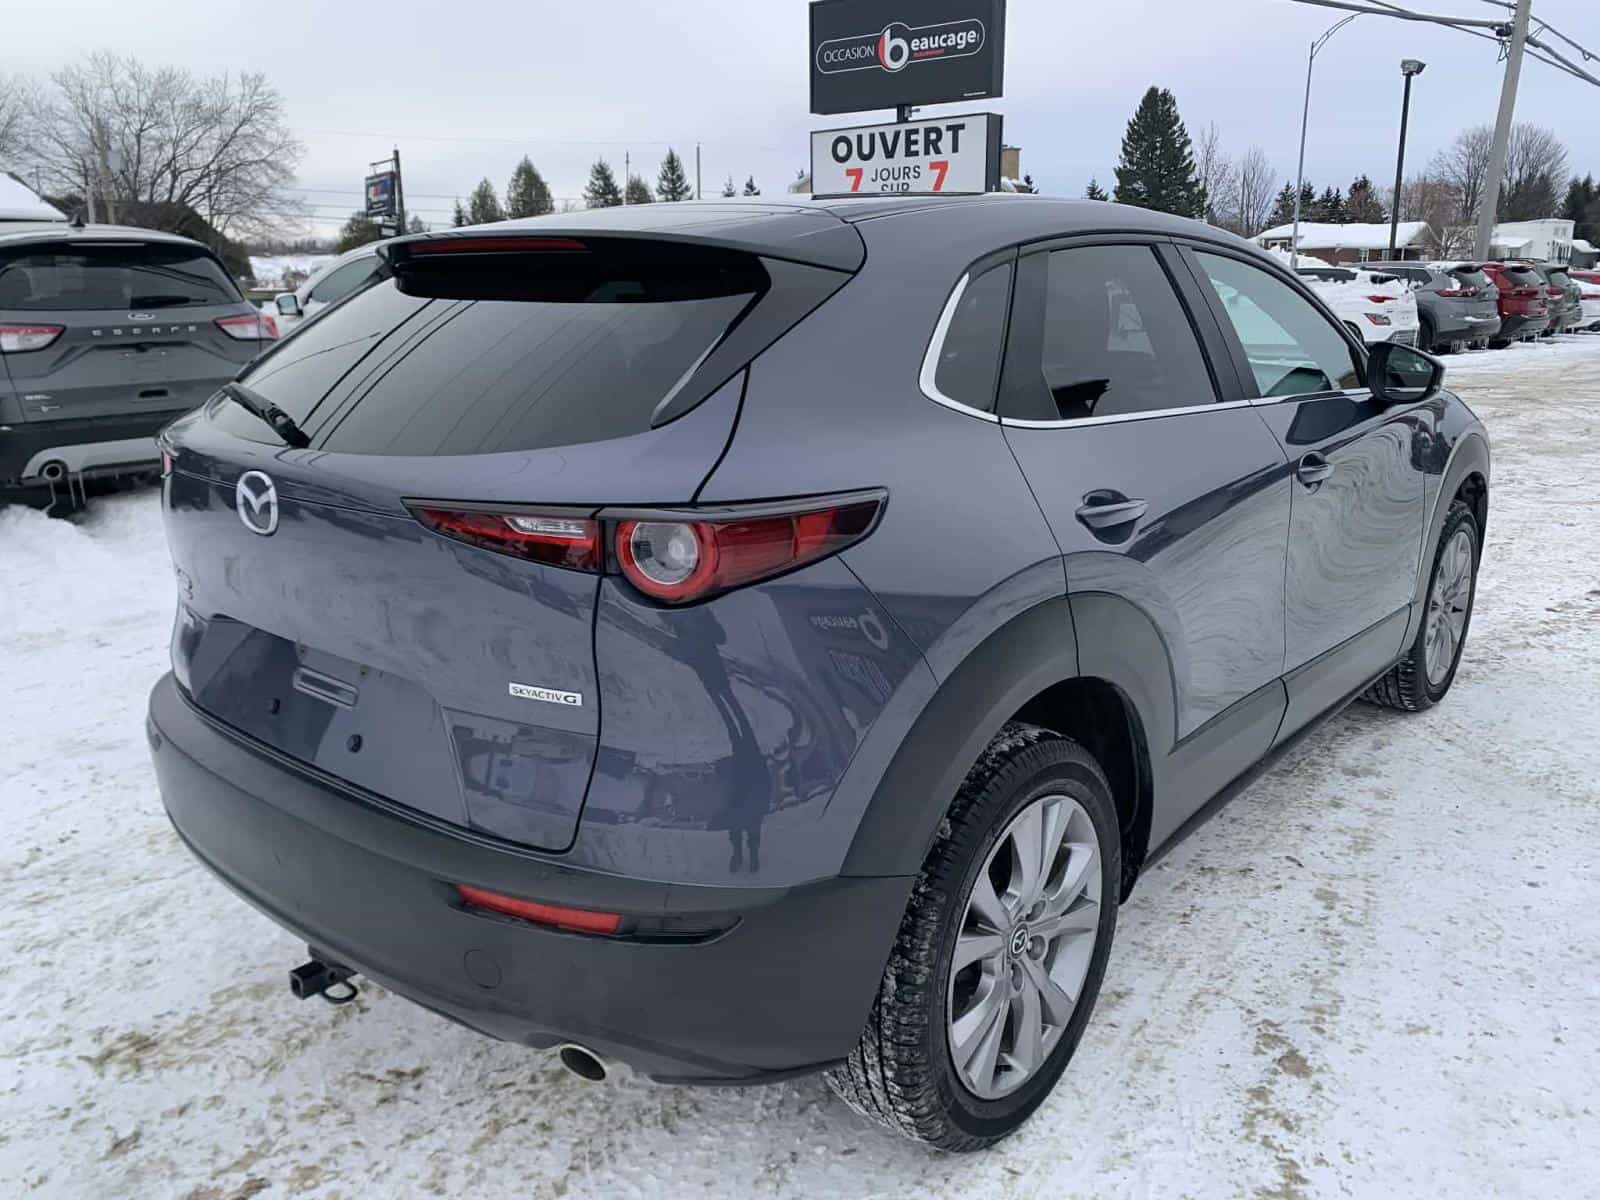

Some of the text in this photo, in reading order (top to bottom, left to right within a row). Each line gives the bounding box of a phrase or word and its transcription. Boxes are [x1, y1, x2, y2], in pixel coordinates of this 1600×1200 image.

[823, 45, 875, 63] OCCASION
[831, 123, 966, 164] OUVERT
[845, 160, 949, 192] 7 JOURS 7
